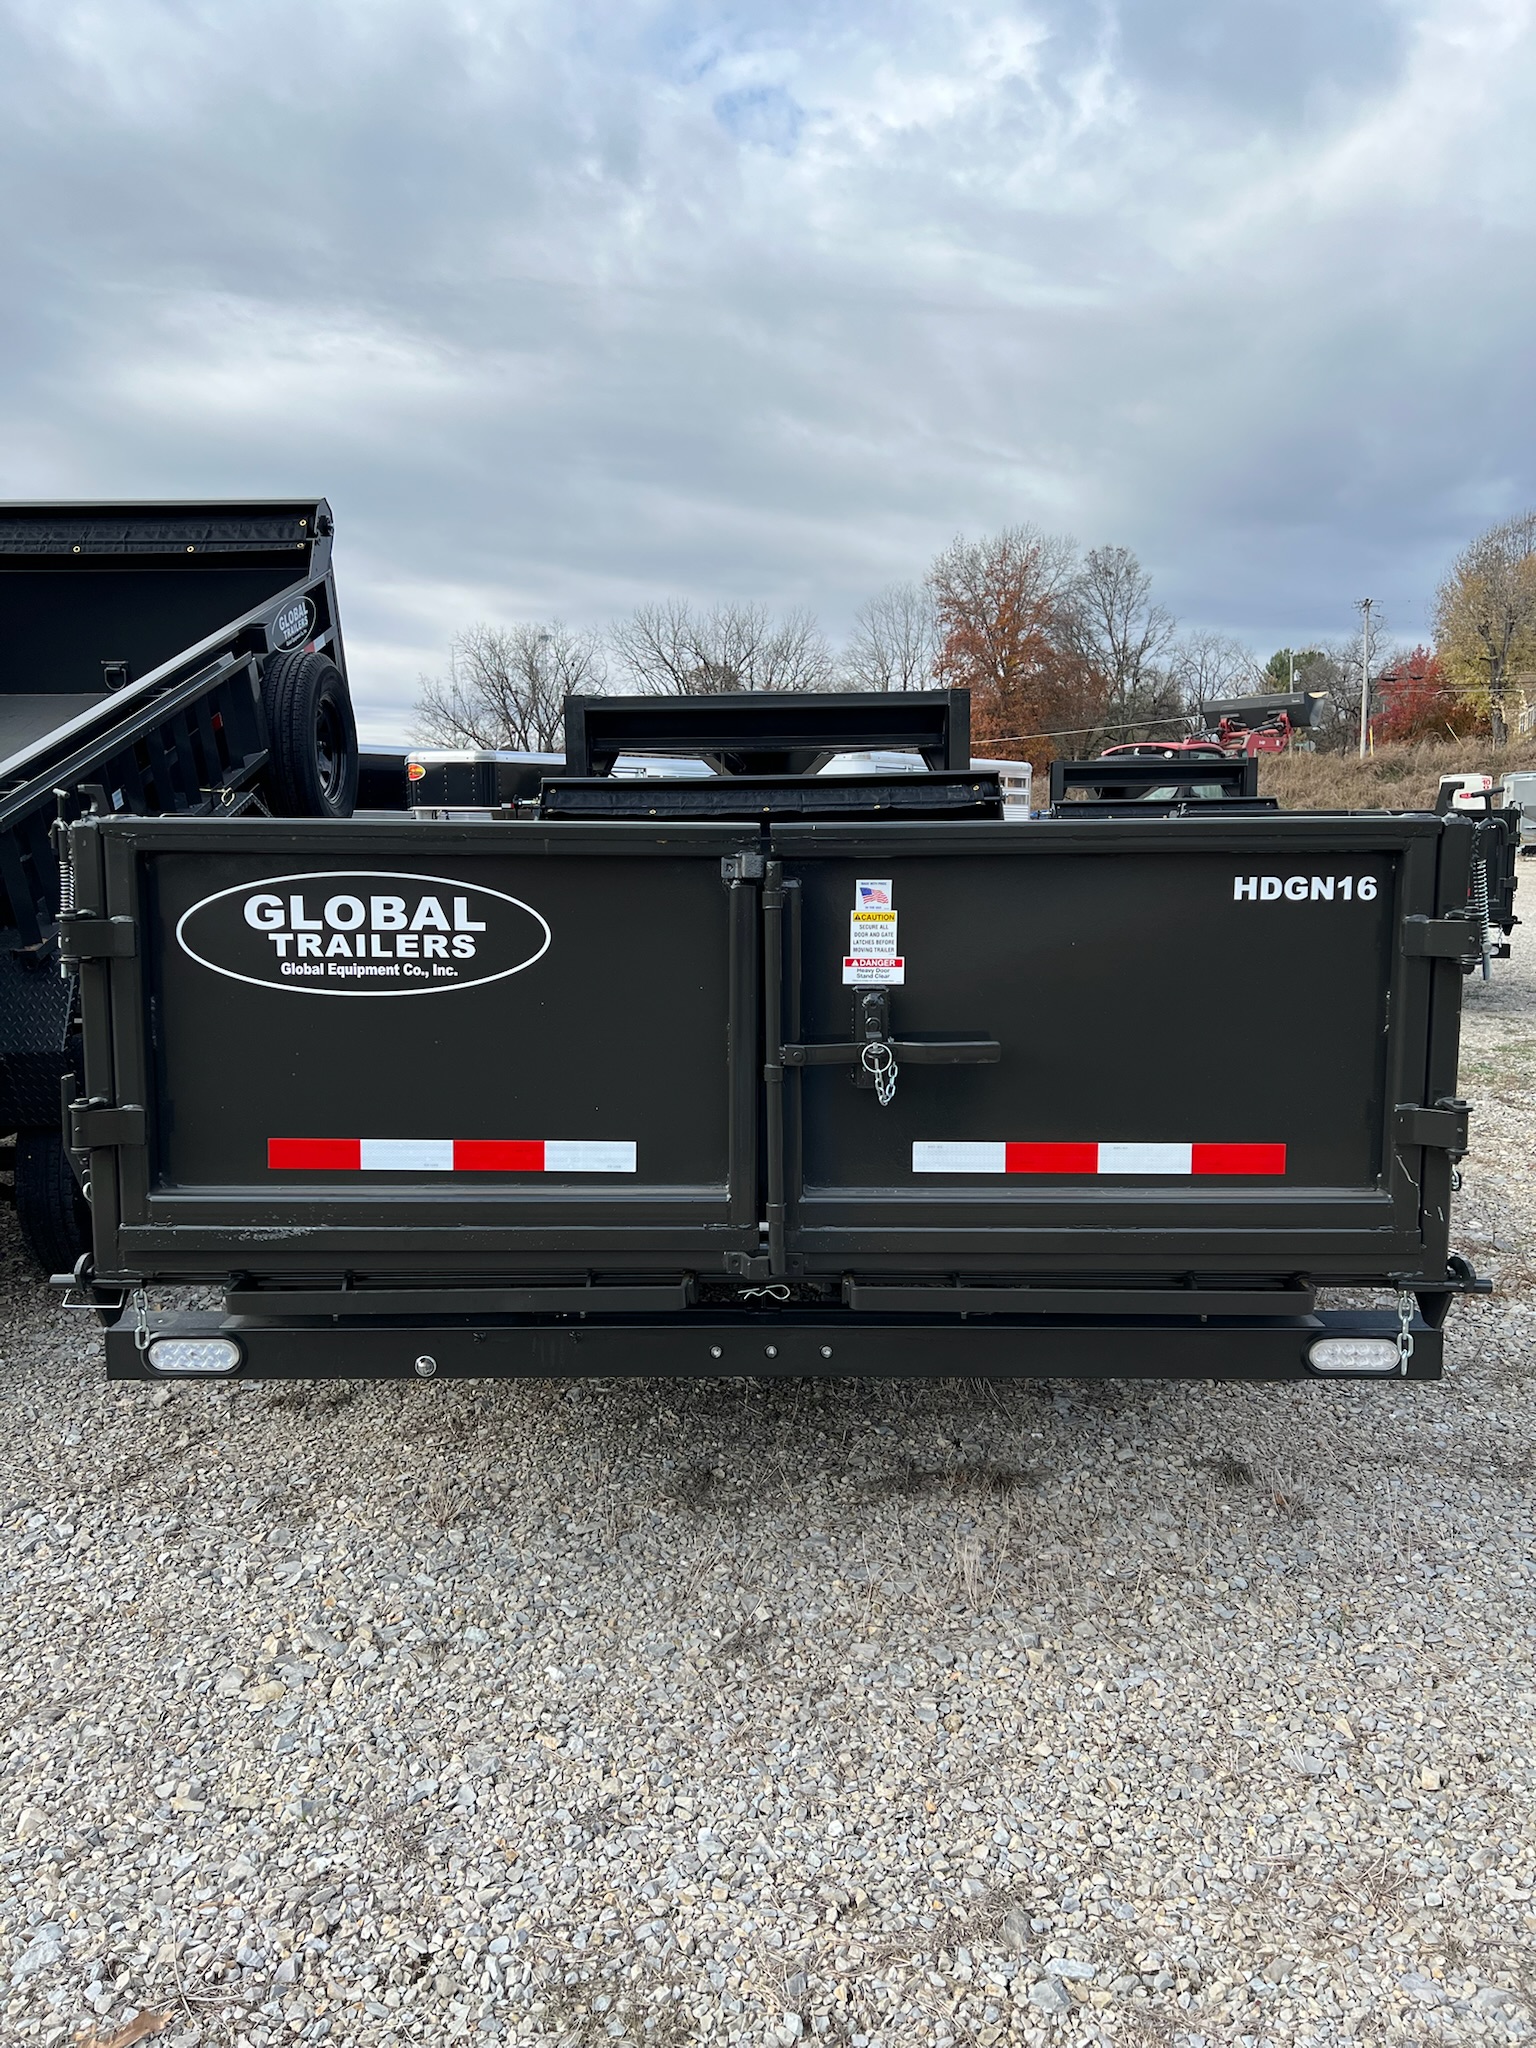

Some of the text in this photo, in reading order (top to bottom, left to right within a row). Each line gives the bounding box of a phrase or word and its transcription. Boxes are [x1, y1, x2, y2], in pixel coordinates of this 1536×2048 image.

[279, 602, 308, 631] GLOBAL
[283, 616, 308, 640] TRAILERS
[1233, 876, 1378, 901] HDGN16
[243, 894, 486, 932] GLOBAL
[268, 933, 477, 959] TRAILERS
[280, 962, 459, 978] Global Equipment Co., Inc.
[860, 959, 896, 967] DANGER
